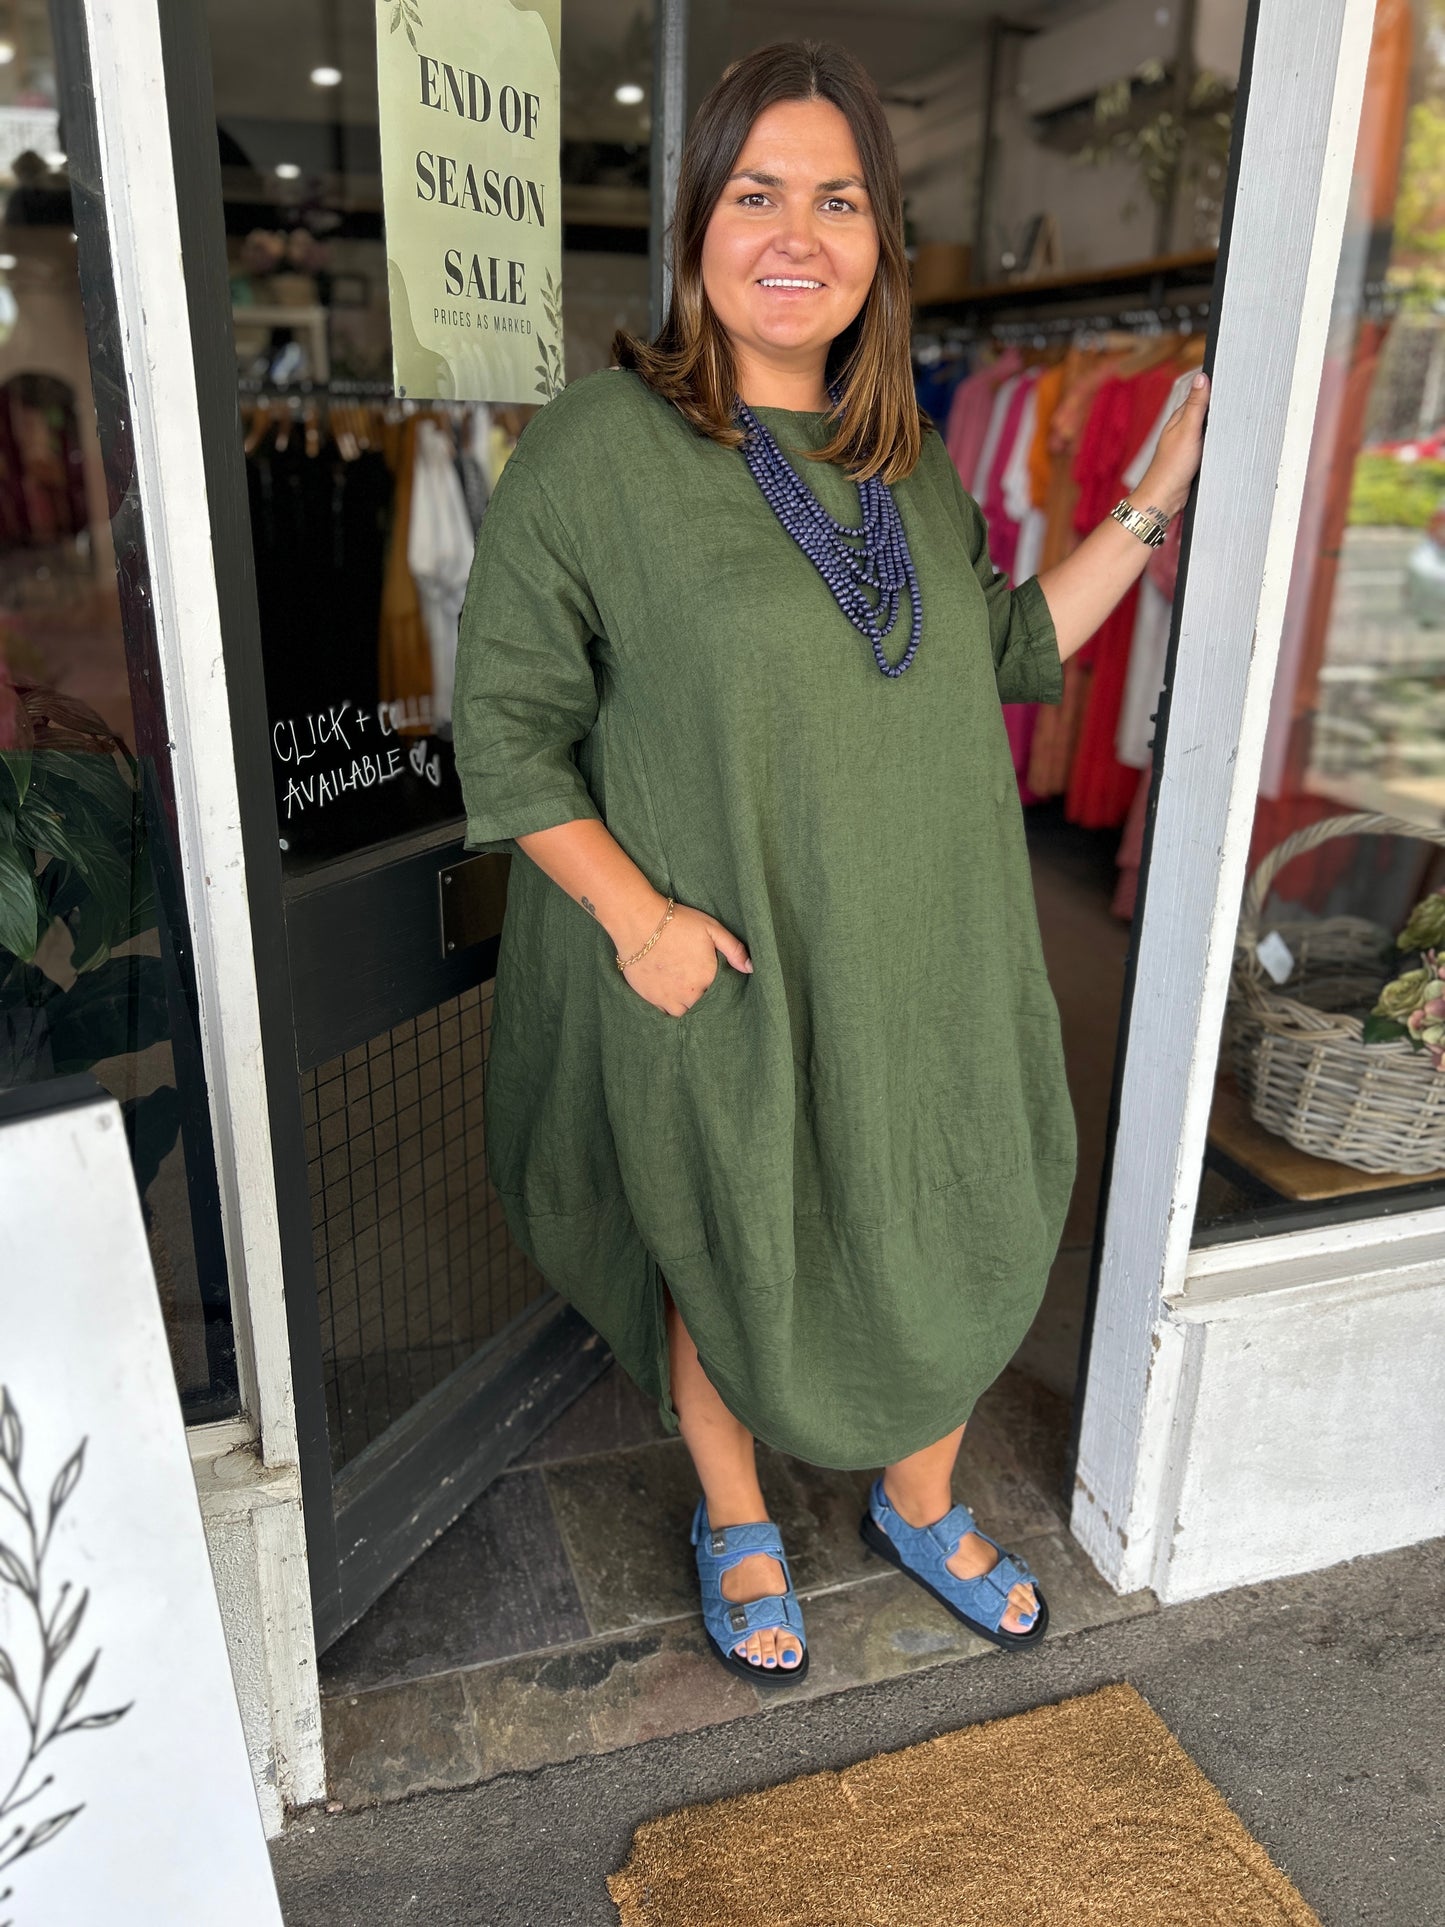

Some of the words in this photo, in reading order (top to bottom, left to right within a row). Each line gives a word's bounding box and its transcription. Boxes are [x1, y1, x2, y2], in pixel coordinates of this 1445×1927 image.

[418, 54, 491, 122] END
[499, 85, 540, 139] OF
[416, 151, 545, 227] SEASON
[444, 249, 527, 305] SALE
[434, 308, 471, 327] PRICES
[477, 313, 489, 329] AS
[494, 315, 532, 334] MARKED
[273, 702, 351, 765] CLICK
[355, 710, 370, 732] +
[283, 748, 404, 819] AVAILABLE
